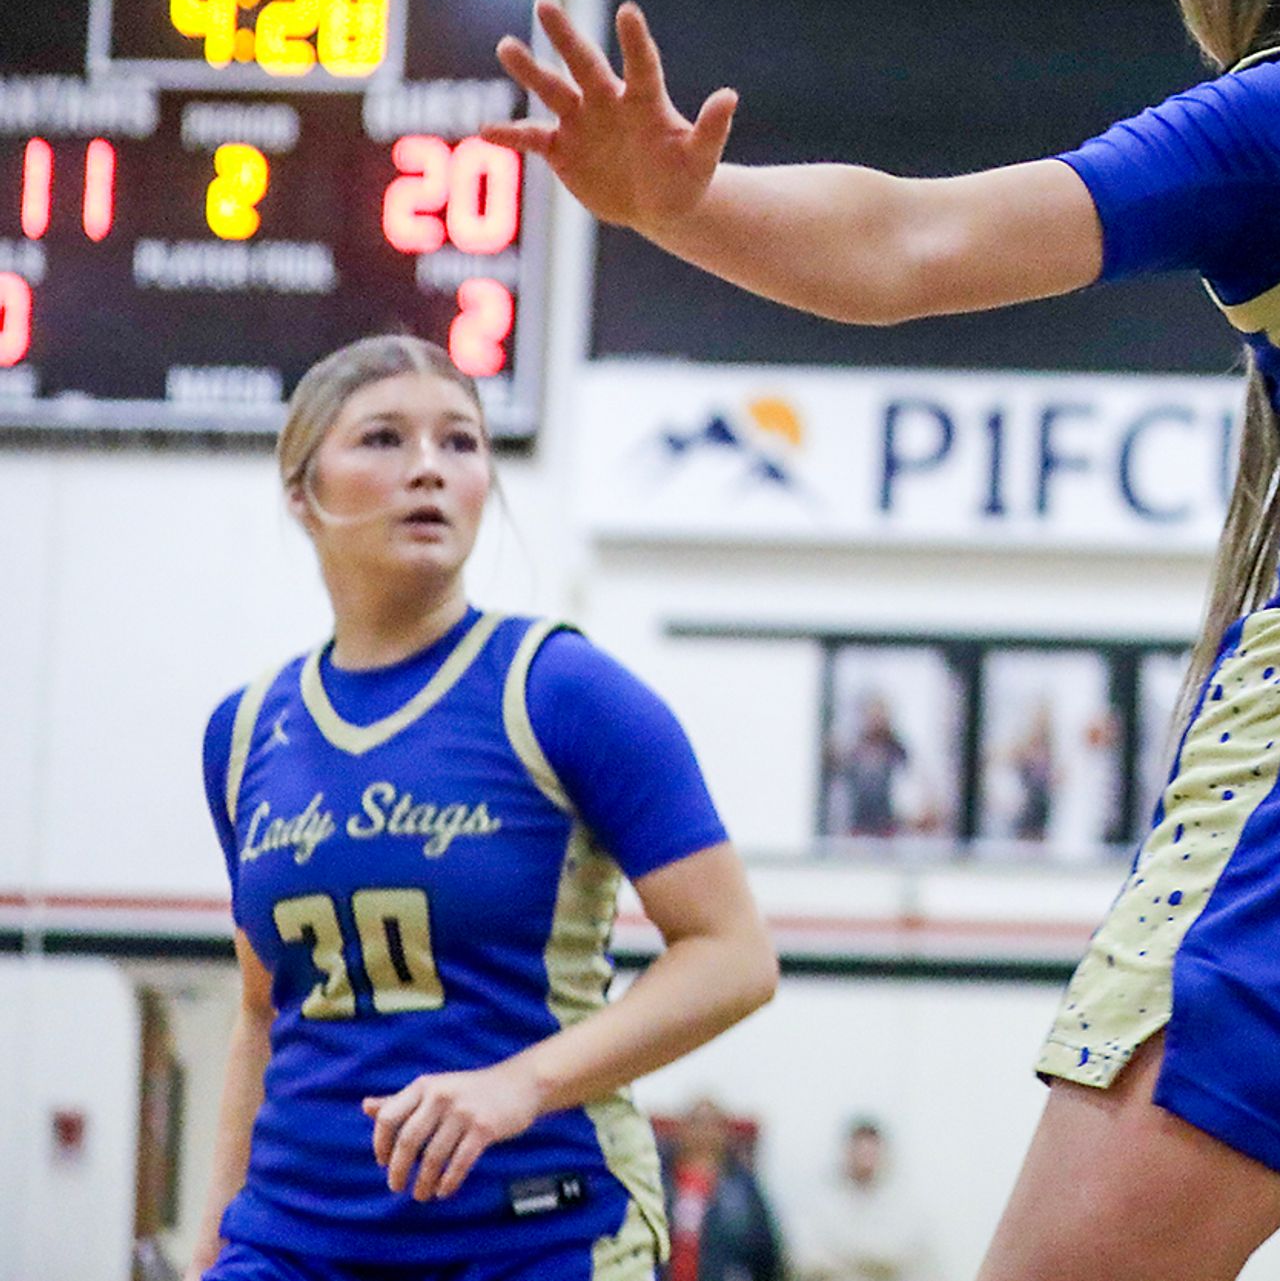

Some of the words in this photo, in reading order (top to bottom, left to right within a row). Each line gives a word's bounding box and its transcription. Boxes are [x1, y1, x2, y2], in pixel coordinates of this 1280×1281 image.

[21, 137, 117, 241] 11
[205, 143, 270, 241] 2
[382, 134, 522, 255] 20
[448, 278, 515, 377] 2
[240, 791, 336, 864] Lady
[346, 781, 501, 860] Stags
[273, 887, 445, 1019] 30
